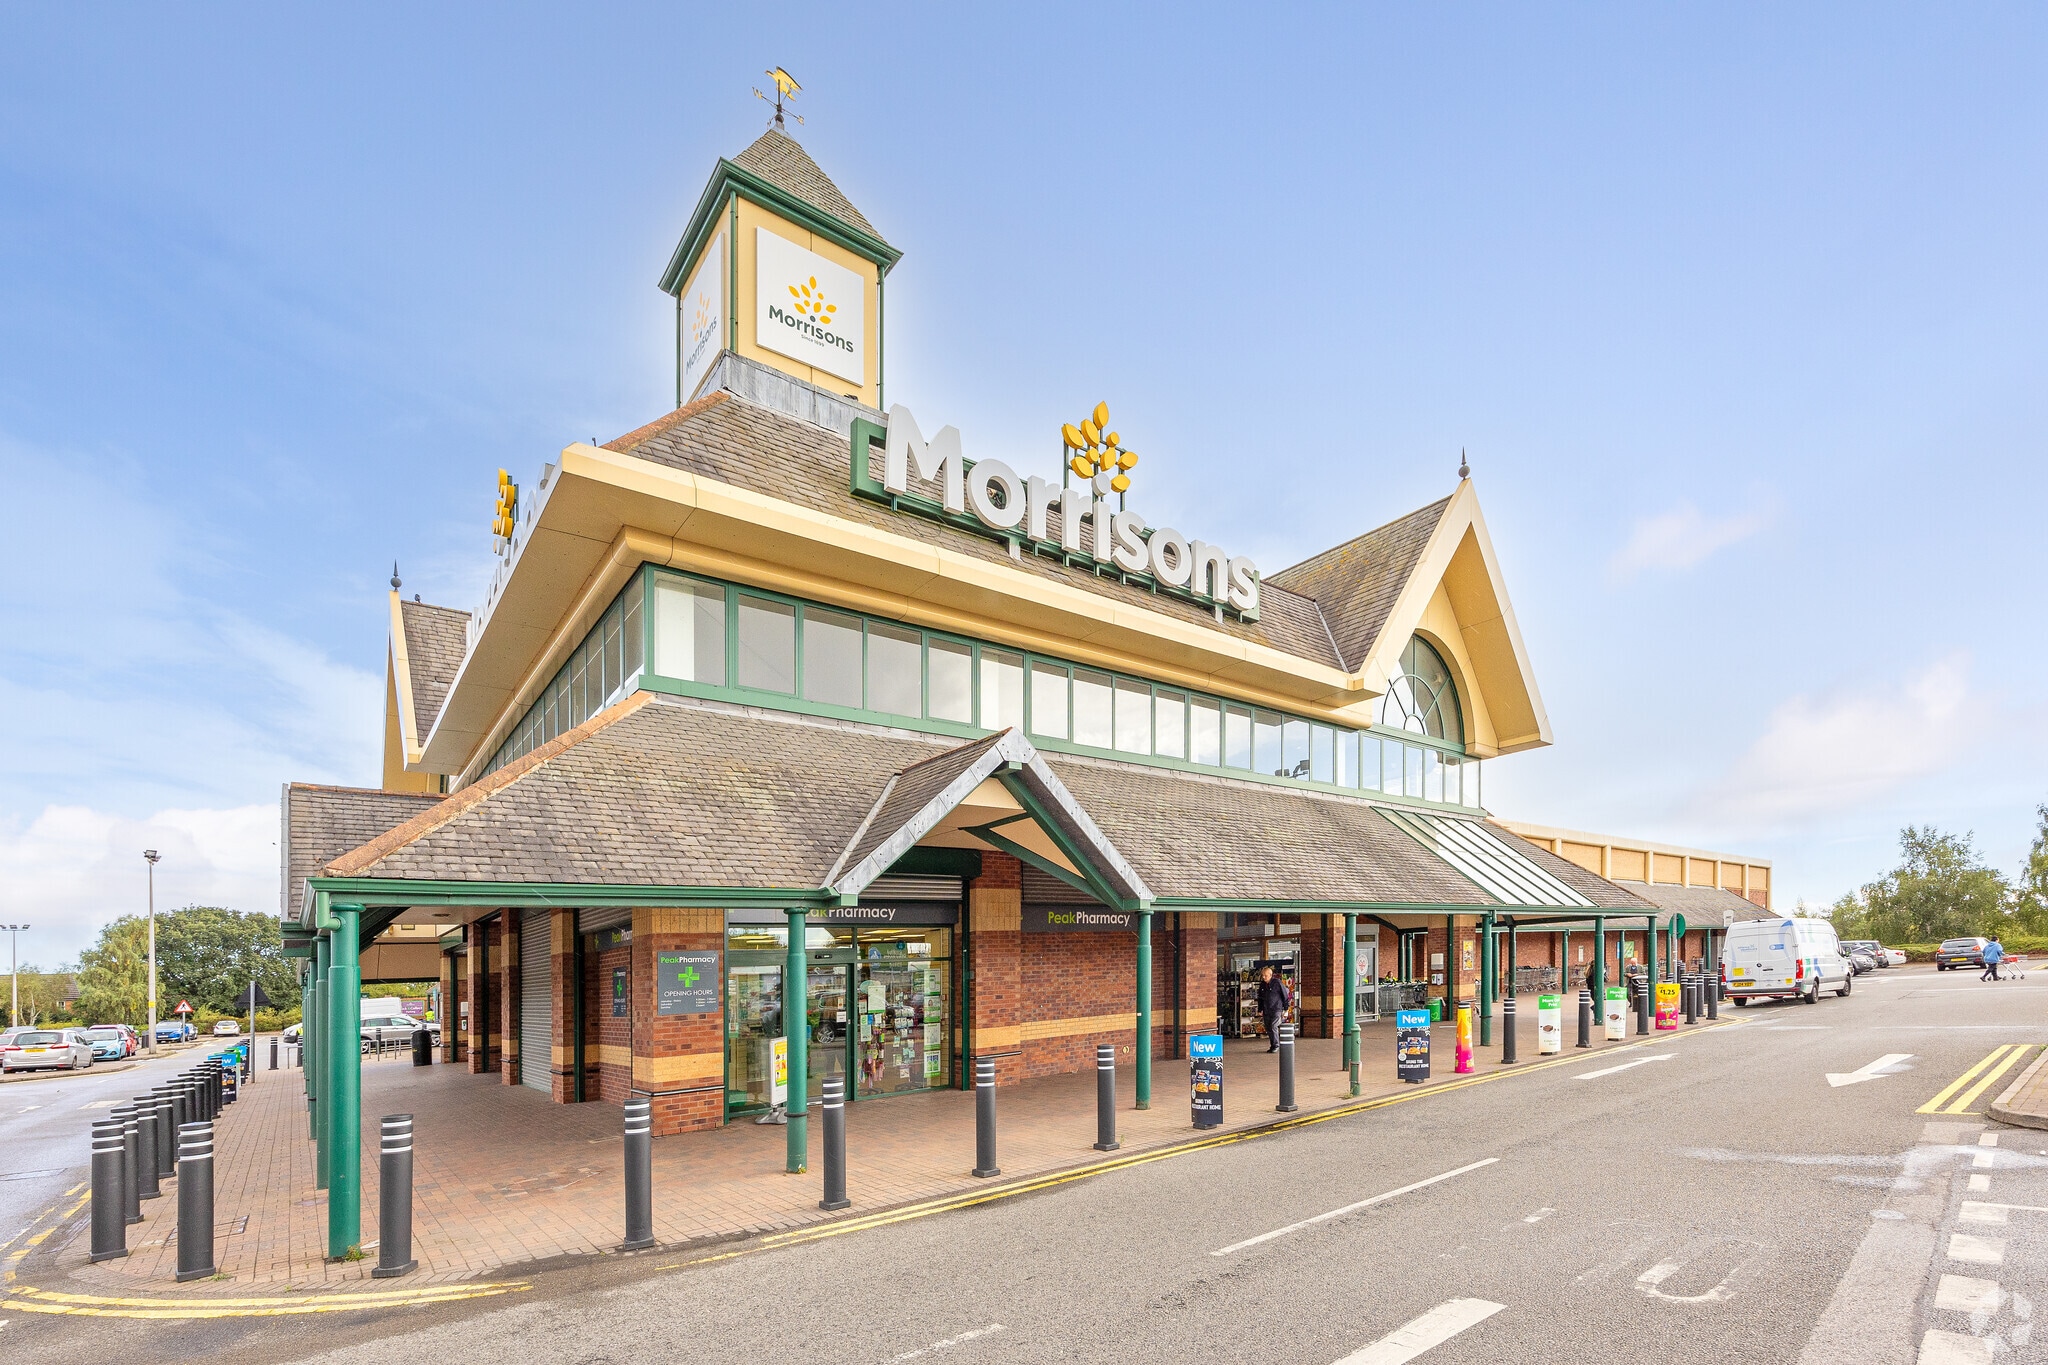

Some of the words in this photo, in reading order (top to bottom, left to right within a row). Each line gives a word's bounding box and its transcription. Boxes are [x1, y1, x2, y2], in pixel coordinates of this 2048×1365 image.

[686, 316, 717, 374] Morrisons
[769, 304, 854, 353] Morrisons
[884, 403, 1257, 611] Morrisons
[1402, 1014, 1426, 1024] New
[1193, 1041, 1216, 1053] New
